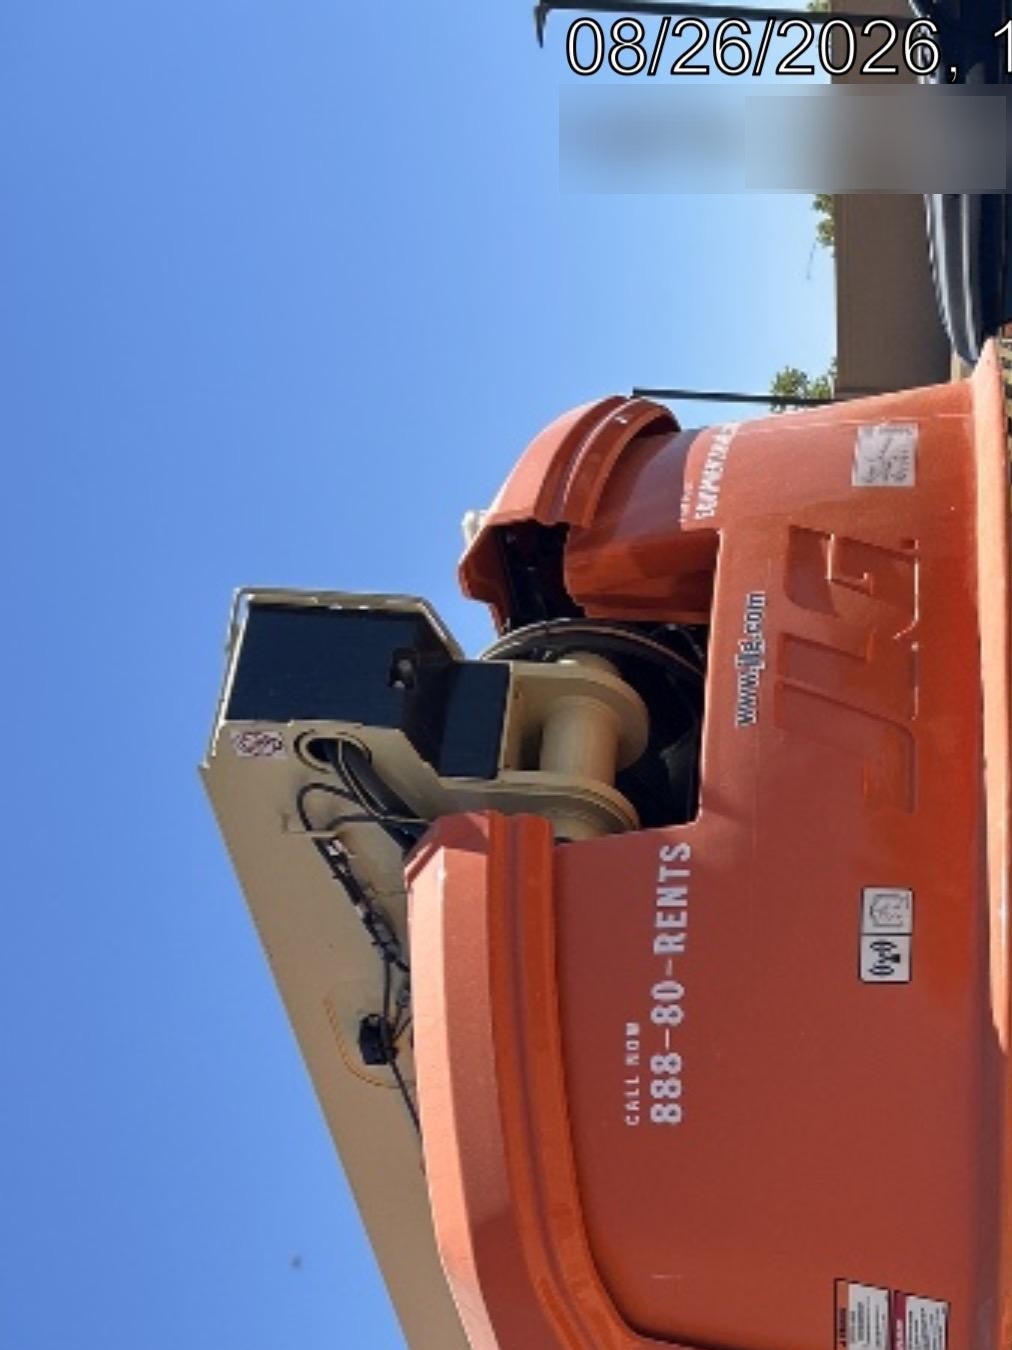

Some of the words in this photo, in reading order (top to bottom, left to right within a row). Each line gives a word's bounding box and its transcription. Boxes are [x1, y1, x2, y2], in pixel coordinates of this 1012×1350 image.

[733, 591, 765, 726] www.jlg.com
[773, 524, 918, 813] JLG
[625, 1022, 640, 1066] NOW
[649, 842, 691, 1124] 888-80-RENTS
[625, 1075, 640, 1126] CALL
